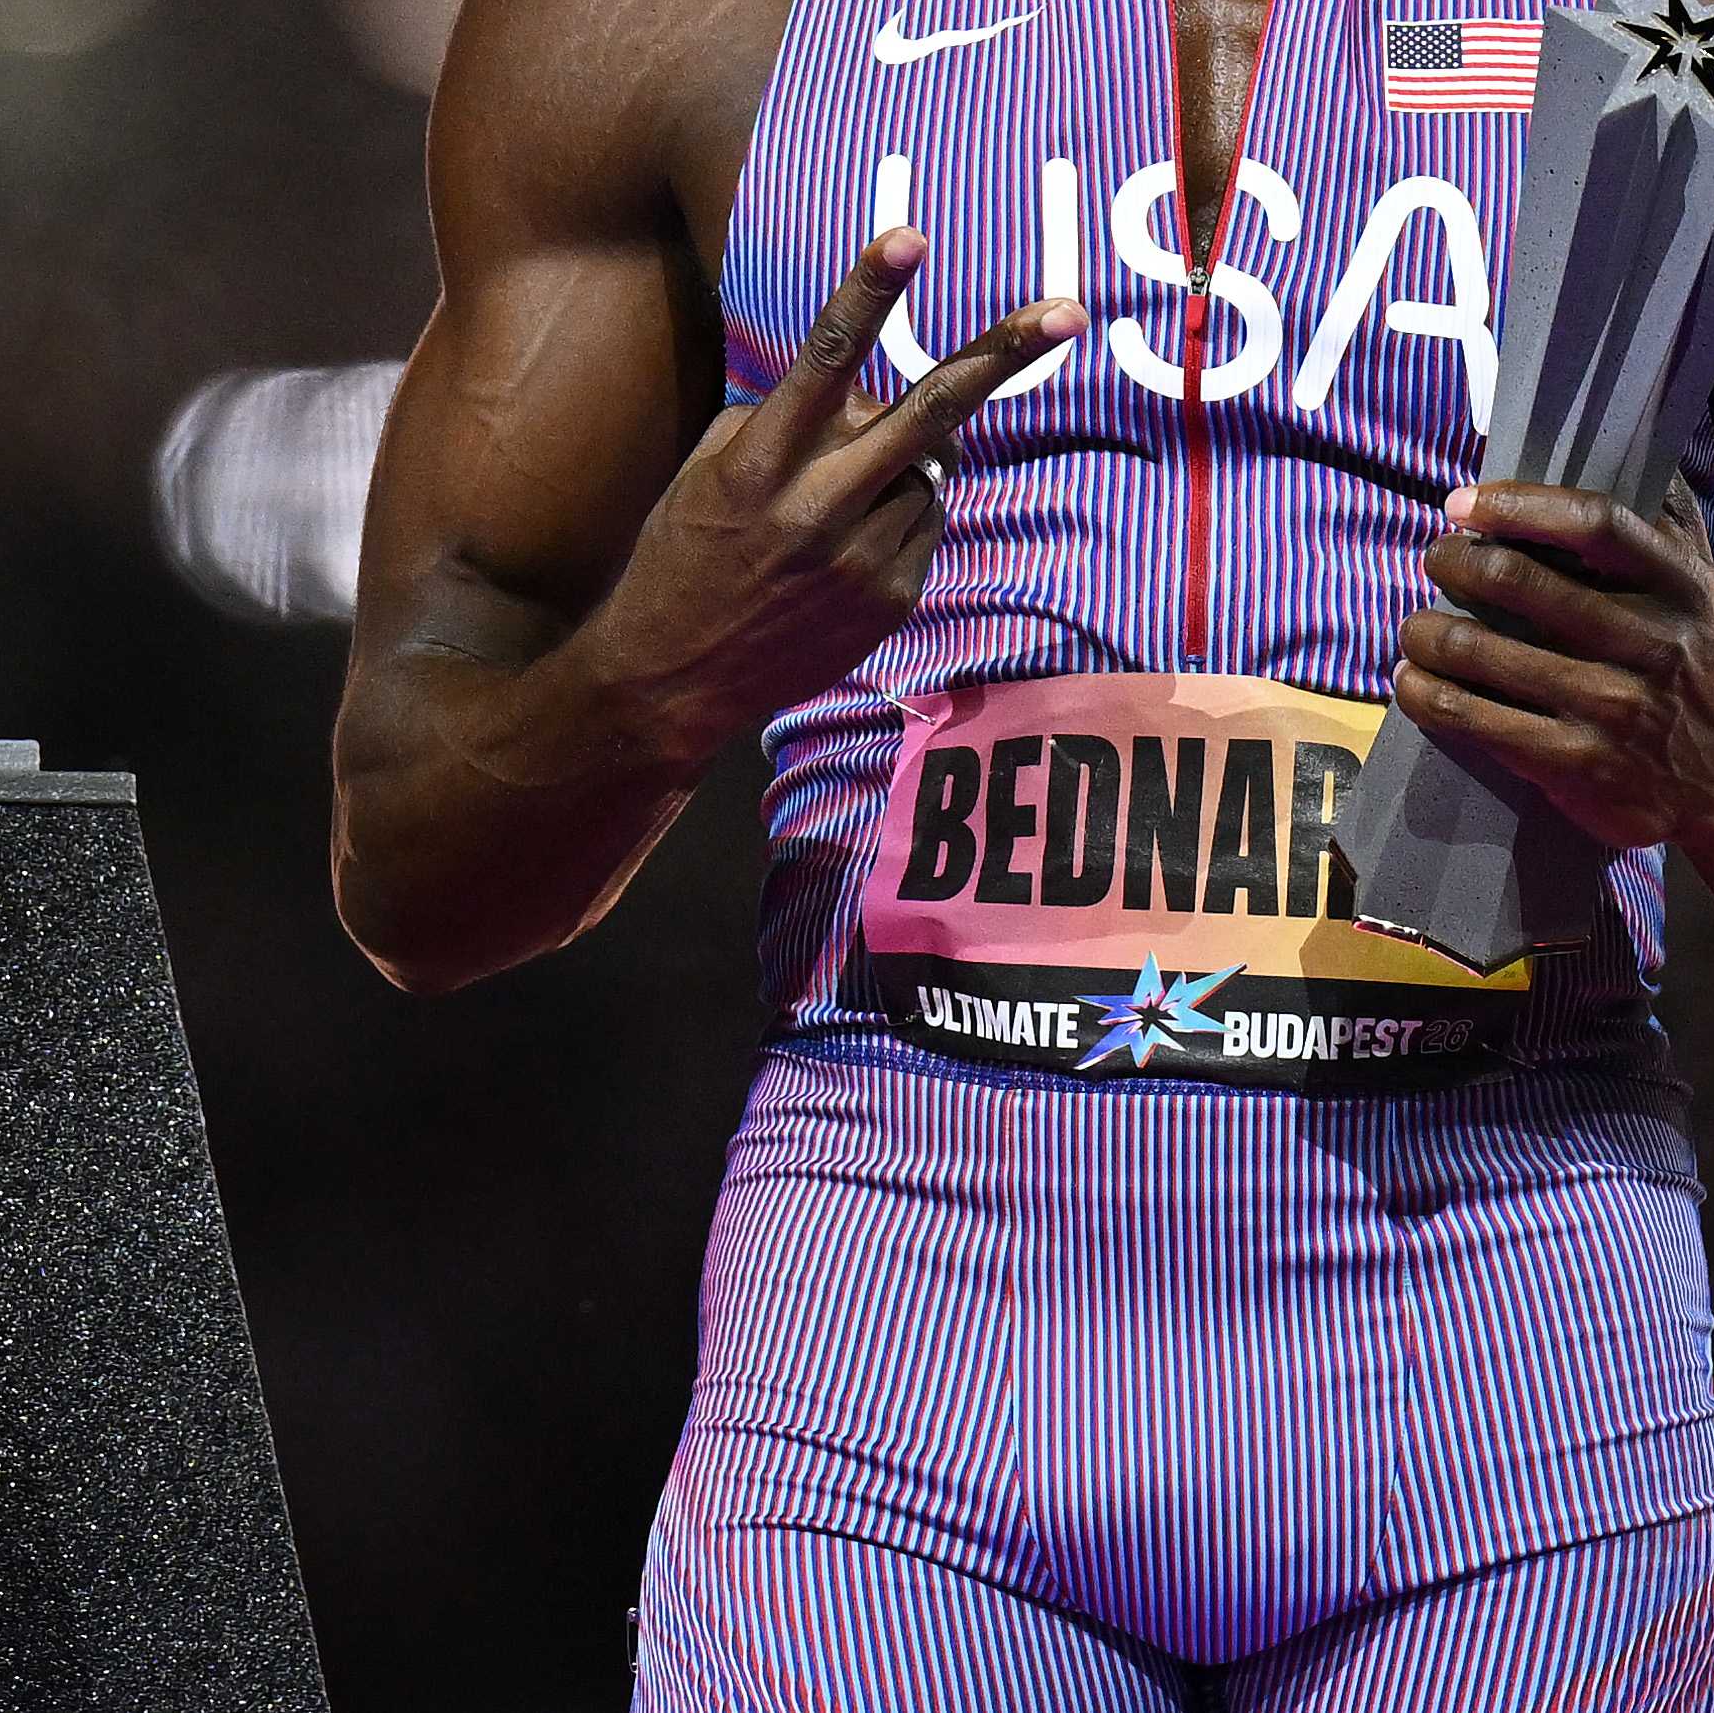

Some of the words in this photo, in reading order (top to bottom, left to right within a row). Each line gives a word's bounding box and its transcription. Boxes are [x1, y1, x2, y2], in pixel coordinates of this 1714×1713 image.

[873, 153, 1500, 436] USA
[917, 986, 1080, 1049] ULTIMATE
[1222, 1010, 1423, 1061] BUDAPEST
[1420, 1018, 1474, 1055] 26
